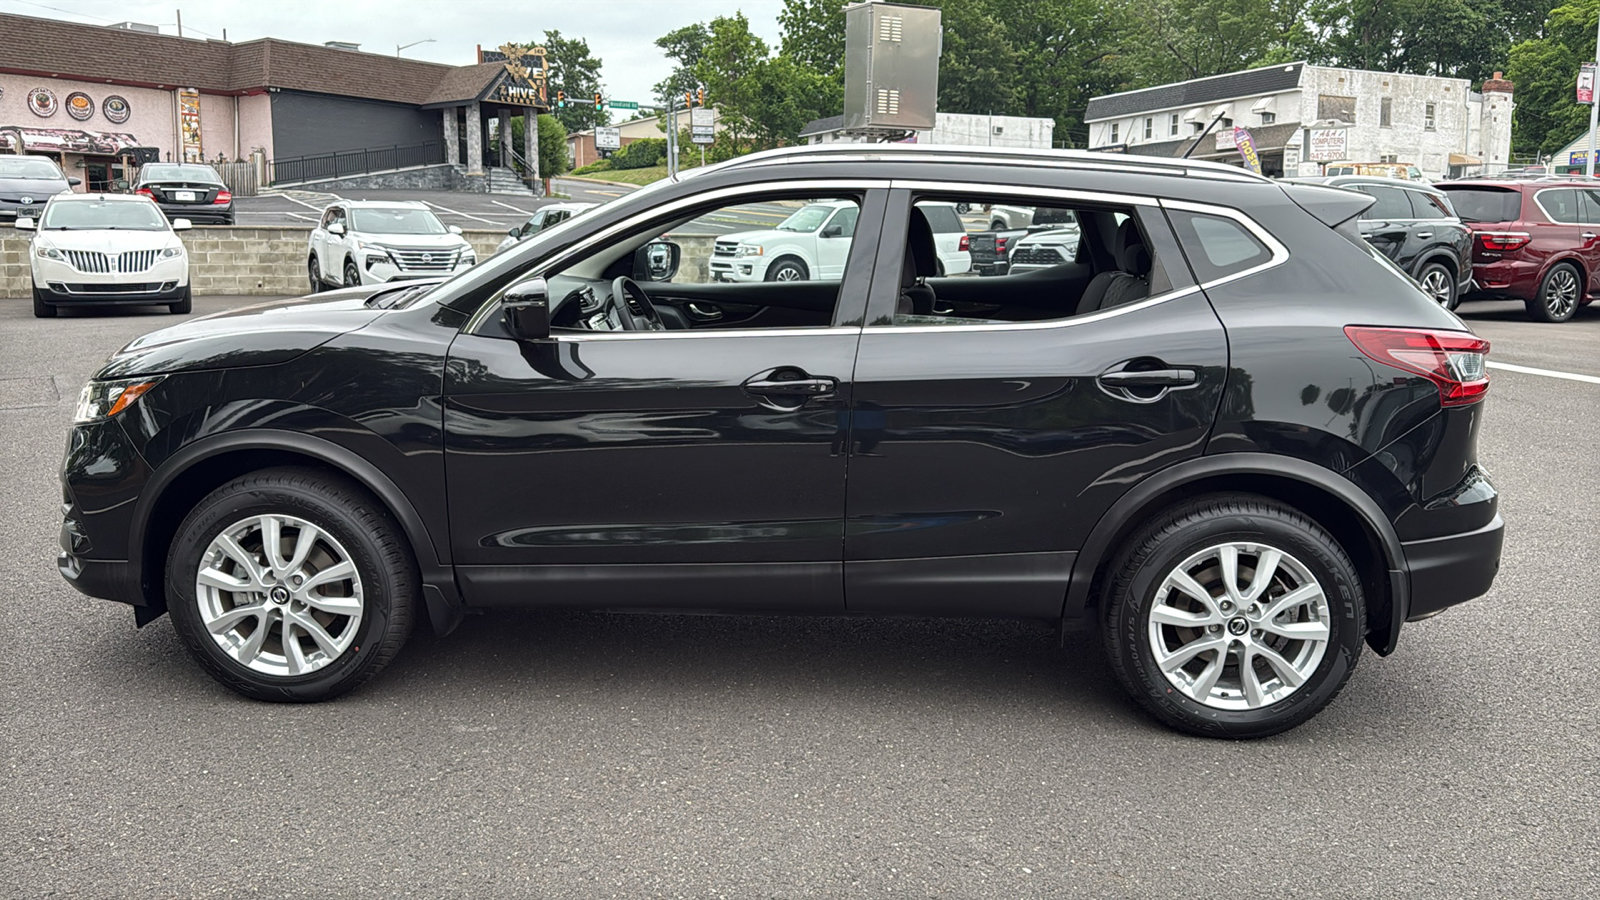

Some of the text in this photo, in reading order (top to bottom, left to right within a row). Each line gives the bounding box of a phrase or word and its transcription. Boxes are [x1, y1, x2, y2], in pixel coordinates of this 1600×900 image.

[524, 66, 543, 79] VE
[508, 86, 535, 100] HIVE
[1312, 137, 1345, 145] COMPUTERS
